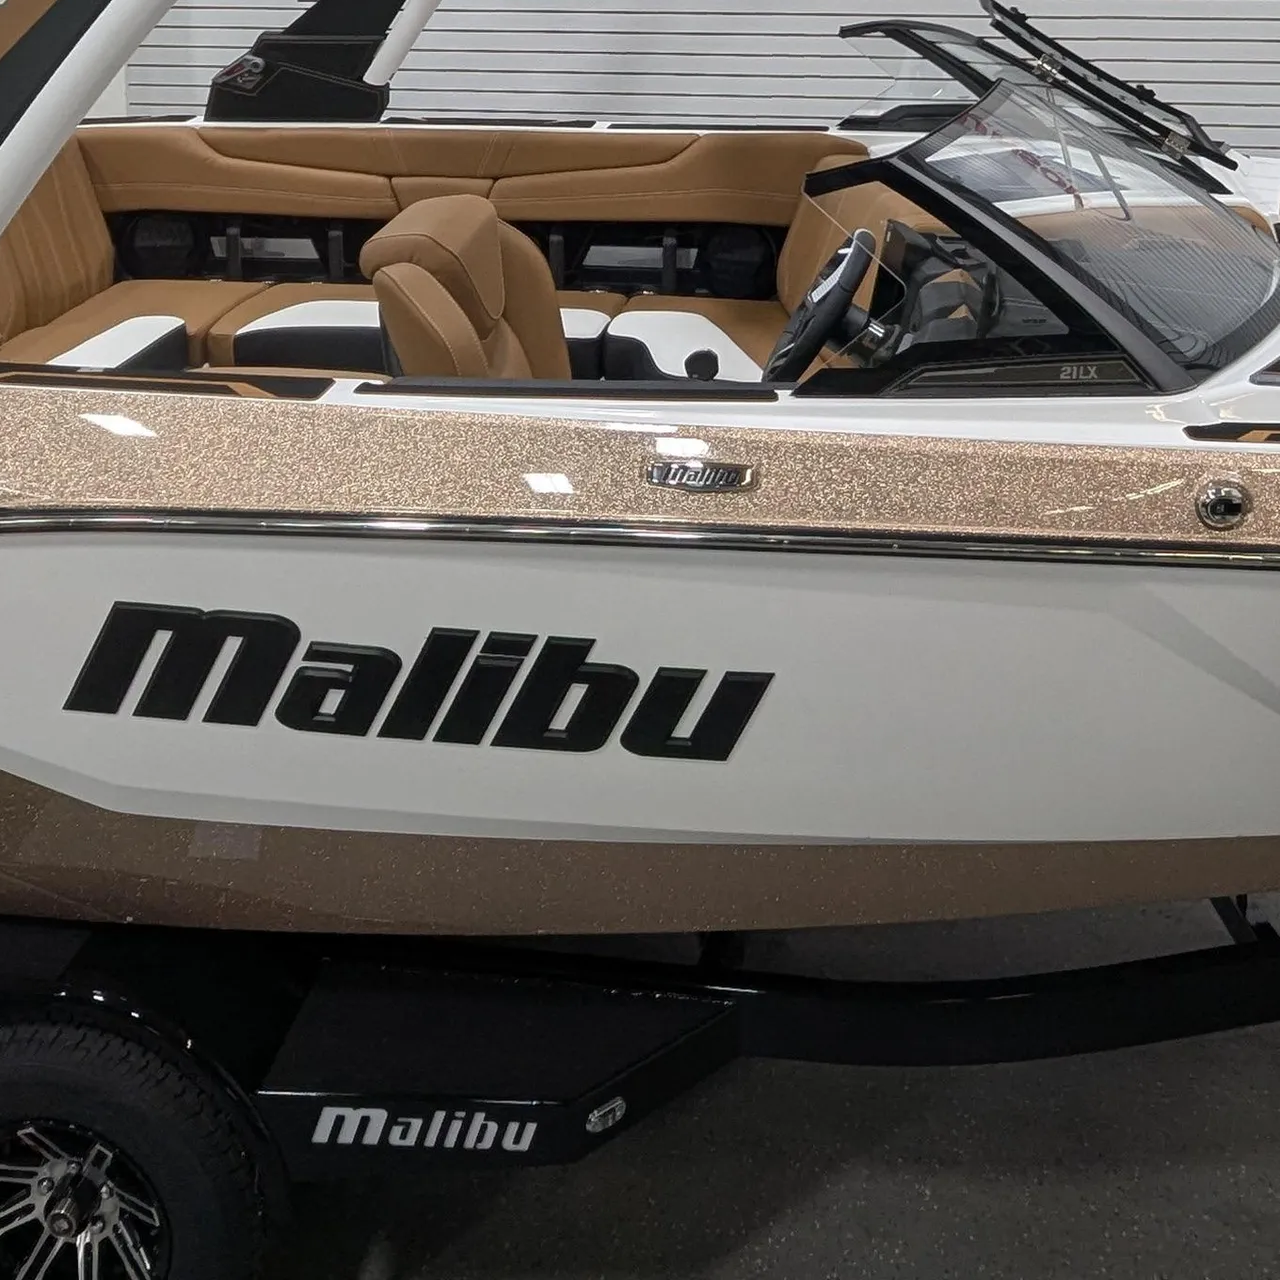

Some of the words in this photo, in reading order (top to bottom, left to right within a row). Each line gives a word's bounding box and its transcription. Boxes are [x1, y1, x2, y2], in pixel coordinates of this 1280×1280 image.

[1060, 364, 1099, 380] 21LX
[61, 600, 775, 762] Malibu
[311, 1106, 538, 1152] Malibu
